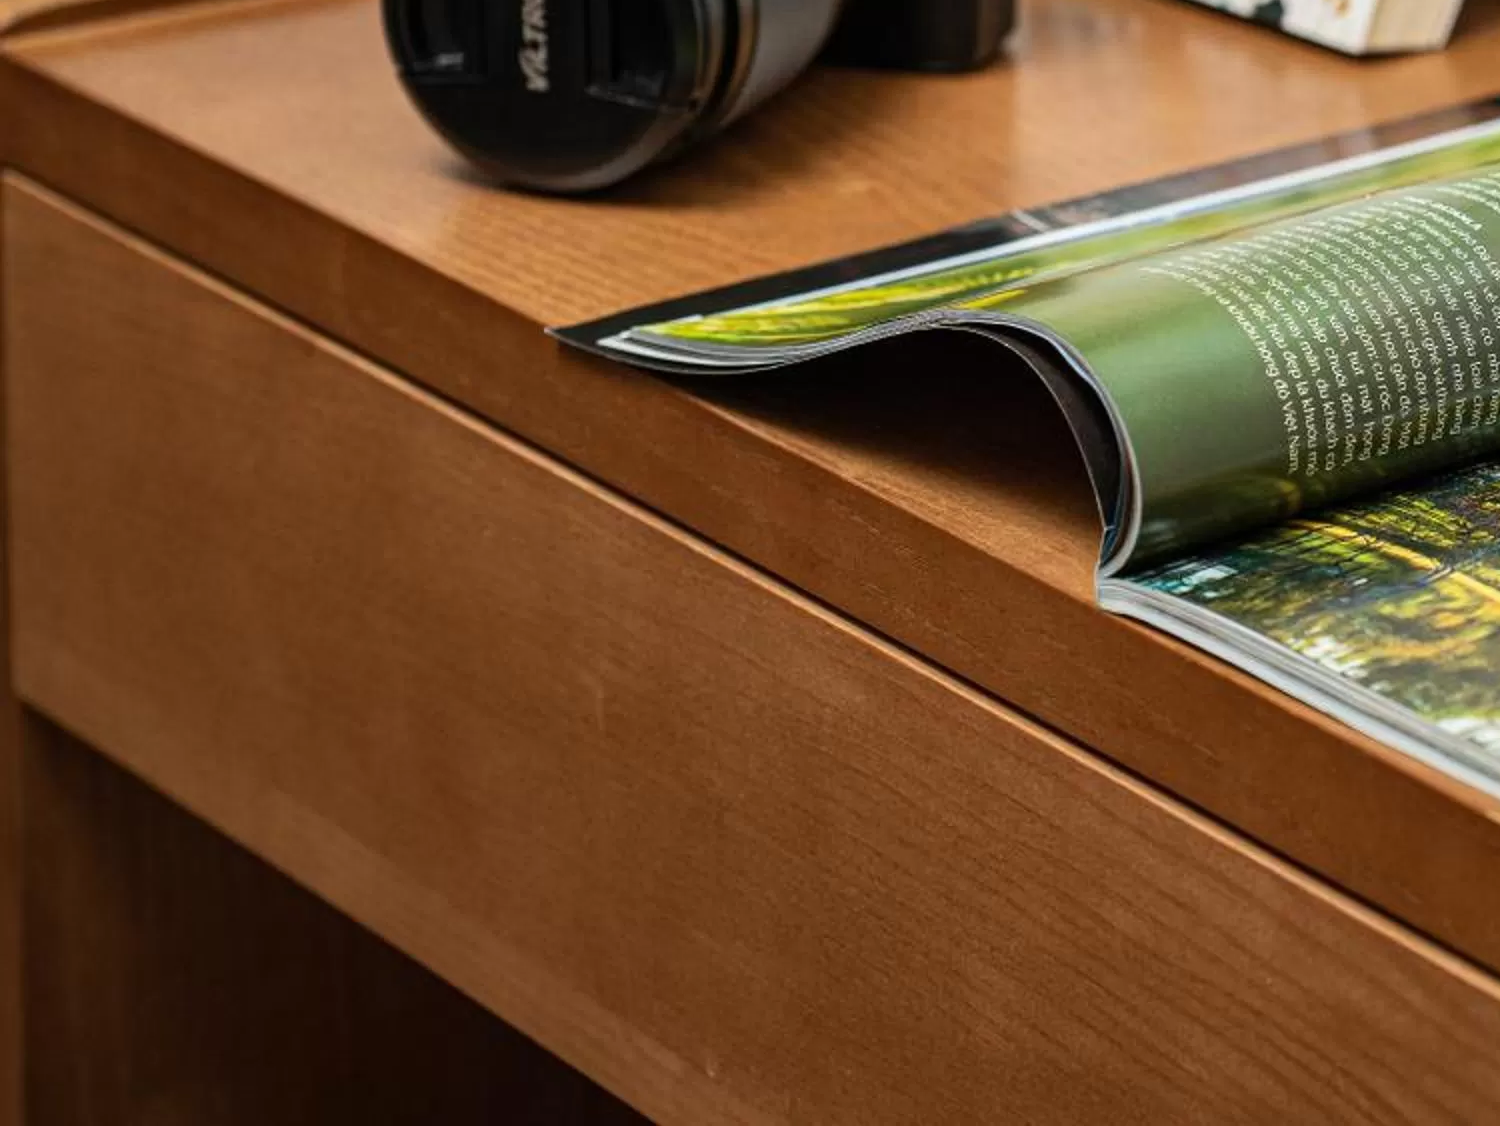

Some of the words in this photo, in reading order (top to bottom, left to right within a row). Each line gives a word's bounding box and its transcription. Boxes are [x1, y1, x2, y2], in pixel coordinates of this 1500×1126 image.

[1380, 331, 1398, 360] hoa
[1432, 312, 1458, 357] quanh
[1316, 378, 1330, 399] du
[1282, 400, 1298, 432] Việt
